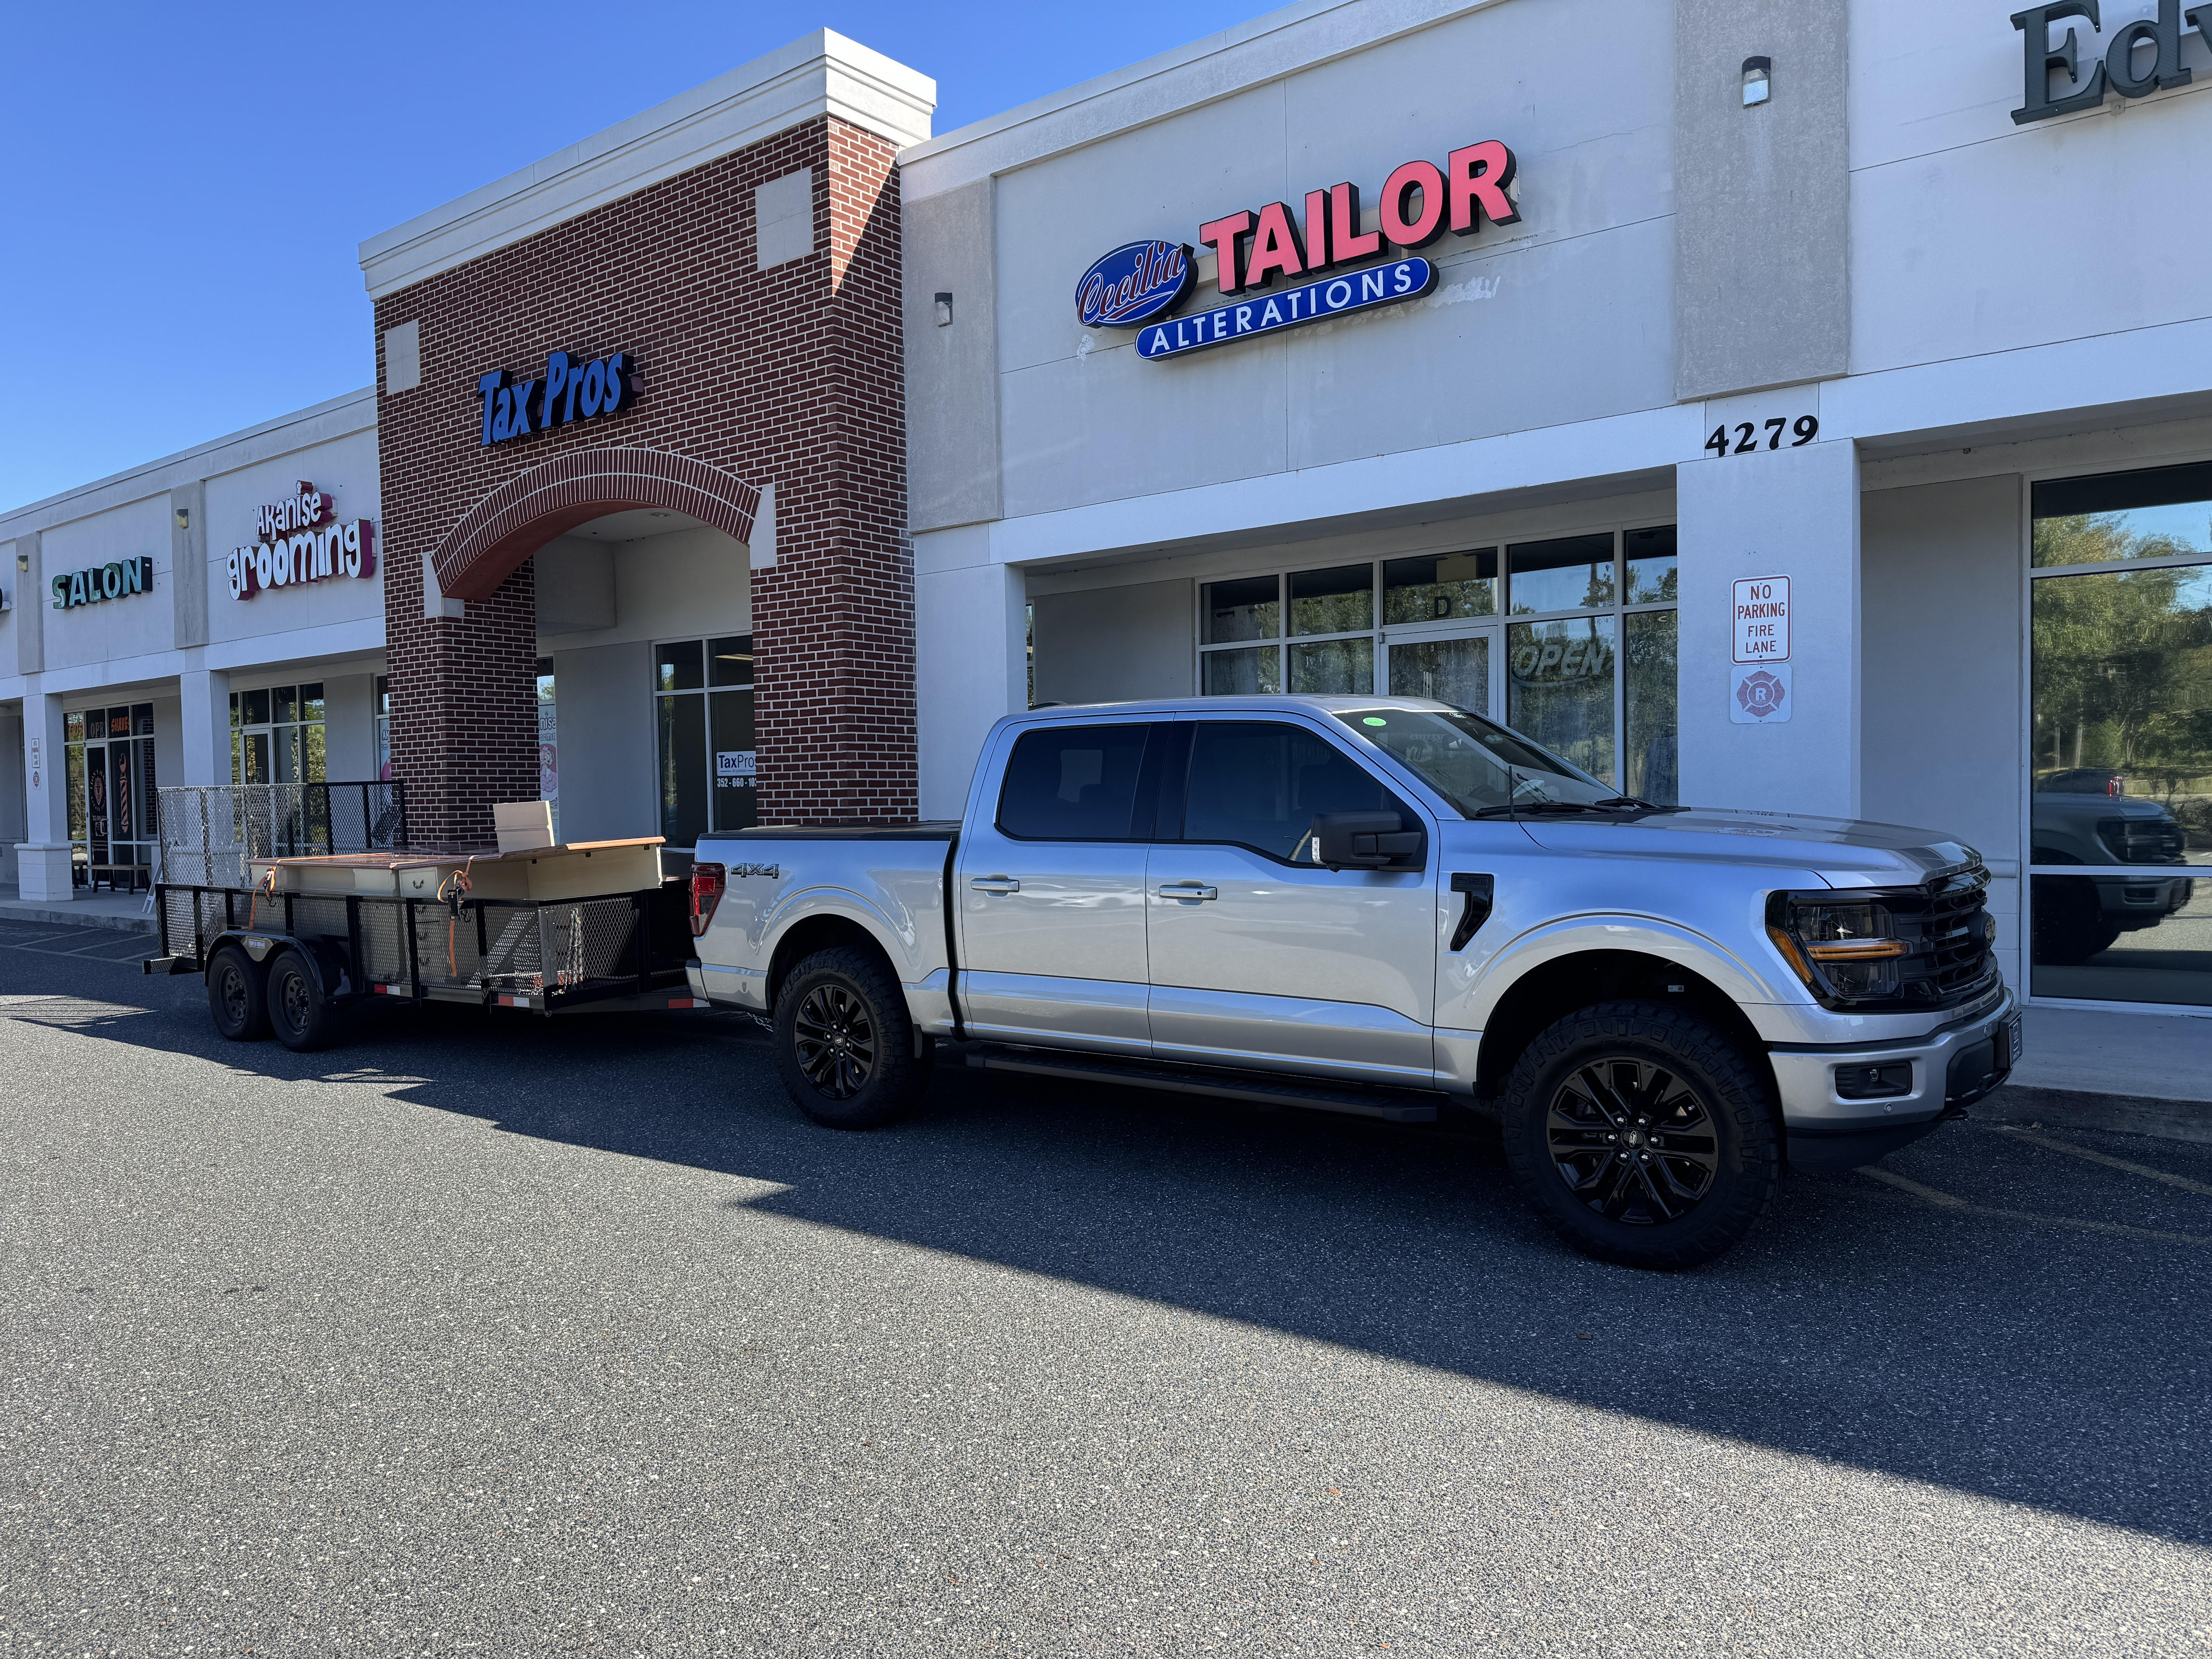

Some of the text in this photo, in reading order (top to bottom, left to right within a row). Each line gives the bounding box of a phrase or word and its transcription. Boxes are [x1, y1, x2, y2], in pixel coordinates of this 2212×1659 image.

[1200, 140, 1516, 294] TAILOR
[1078, 241, 1185, 325] Cecilia
[1149, 264, 1412, 354] ALTERATIONS
[479, 351, 623, 446] Tax Pros
[1705, 415, 1819, 457] 4279
[226, 519, 362, 601] grooming
[52, 557, 143, 610] SALON
[1751, 584, 1771, 600] NO
[1434, 596, 1451, 618] D
[1738, 602, 1785, 620] PARKING
[1748, 624, 1775, 637] FIRE
[1514, 643, 1608, 678] OPEN
[1745, 640, 1777, 654] LANE
[1755, 687, 1767, 701] R
[718, 754, 756, 768] TaxPro
[1454, 876, 1488, 884] F-150
